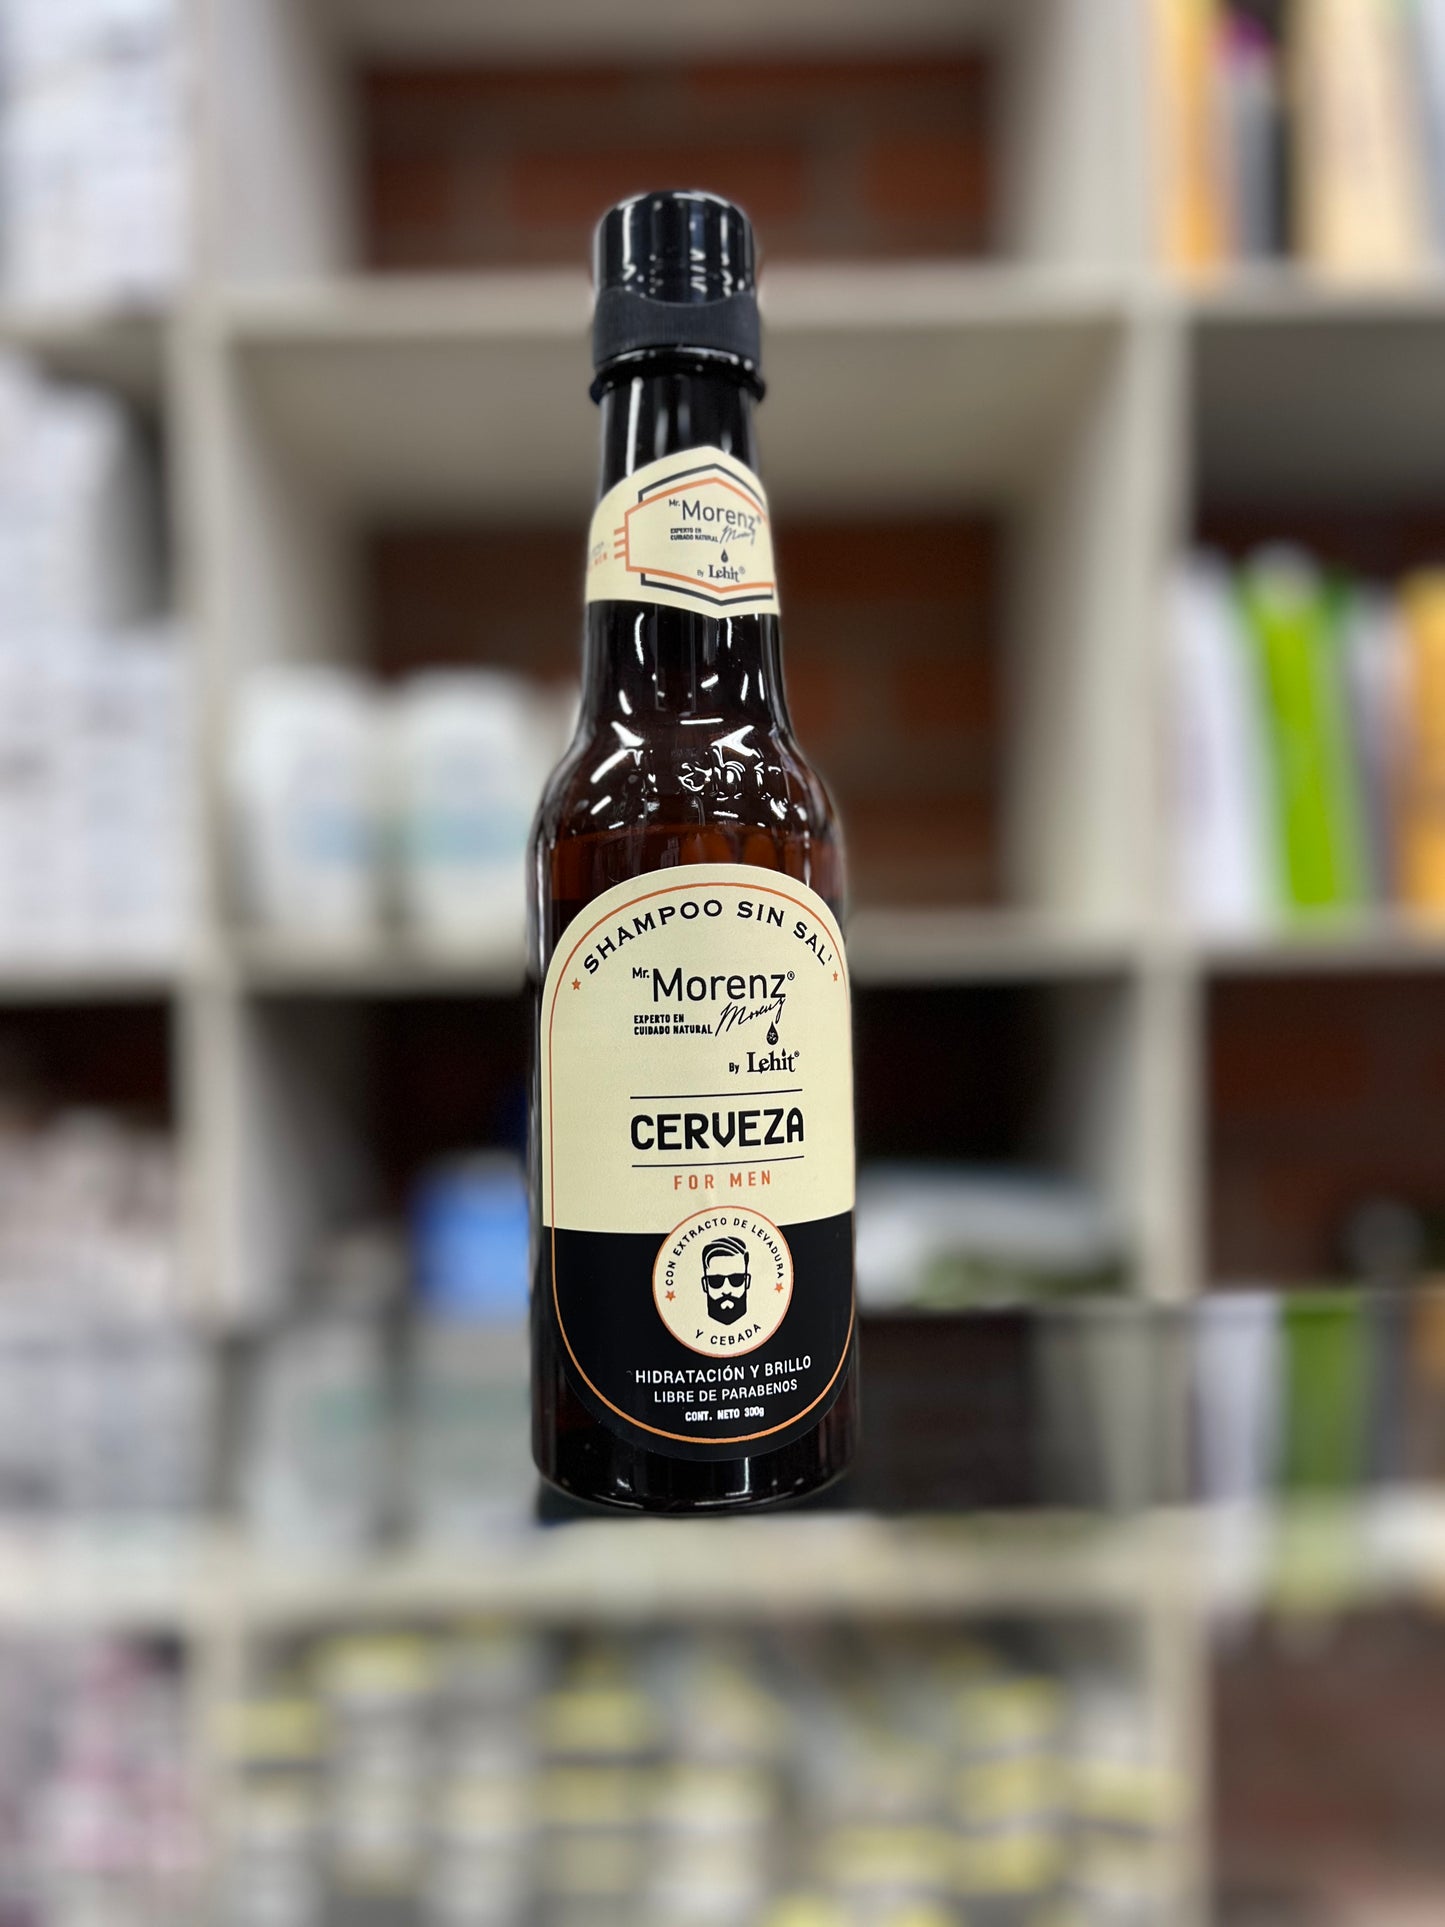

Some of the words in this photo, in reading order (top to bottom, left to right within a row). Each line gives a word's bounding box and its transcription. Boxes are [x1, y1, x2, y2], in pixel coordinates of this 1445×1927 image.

[583, 899, 723, 975] SHAMPOO
[737, 900, 785, 928] SIN
[632, 967, 650, 979] Mr.
[633, 1014, 671, 1024] EXPERTO
[673, 1013, 685, 1023] EN
[633, 1025, 671, 1036] CUIDADO
[673, 1024, 713, 1035] NATURAL
[728, 1062, 740, 1074] By
[630, 1107, 804, 1150] CERVEZA
[673, 1174, 715, 1191] FOR
[729, 1169, 771, 1188] MEN
[665, 1260, 677, 1286] CON
[672, 1217, 727, 1257] EXTRACTO
[733, 1217, 748, 1229] DE
[751, 1224, 785, 1279] LEVADURA
[695, 1329, 704, 1340] Y
[710, 1323, 762, 1346] CEBADA
[635, 1365, 745, 1384] HIDRATACIÓN
[750, 1364, 760, 1378] Y
[764, 1355, 812, 1377] BRILLO
[654, 1390, 695, 1403] LIBRE
[699, 1389, 718, 1402] DE
[721, 1378, 798, 1401] PARABENOS
[685, 1410, 713, 1422] CONT.
[717, 1408, 740, 1420] NETO
[744, 1406, 765, 1417] 300g
